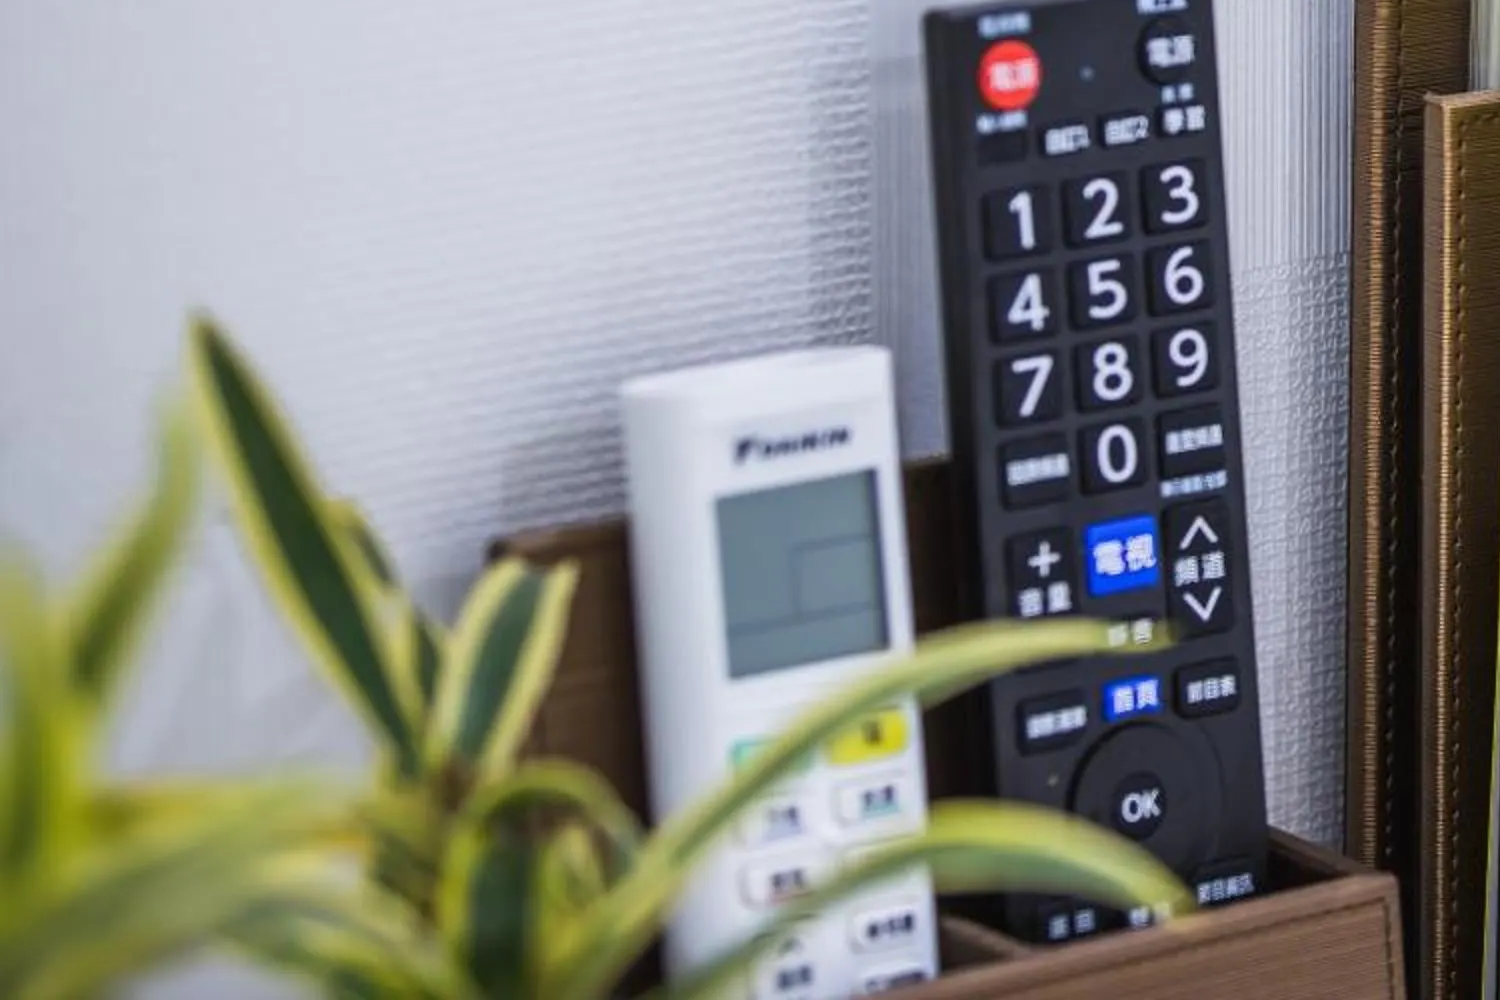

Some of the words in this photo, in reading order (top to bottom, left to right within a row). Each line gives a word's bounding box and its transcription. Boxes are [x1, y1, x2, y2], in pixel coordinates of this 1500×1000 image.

[1009, 191, 1036, 250] 1
[1082, 178, 1125, 240] 2
[1160, 165, 1200, 224] 3
[1007, 273, 1050, 331] 4
[1086, 259, 1128, 319] 5
[1163, 246, 1205, 304] 6
[1011, 355, 1054, 418] 7
[1092, 342, 1133, 400] 8
[1168, 329, 1209, 387] 9
[1096, 424, 1138, 483] 0
[1092, 533, 1157, 576] 電視
[1174, 551, 1226, 587] 頻道
[1120, 788, 1162, 823] OK
